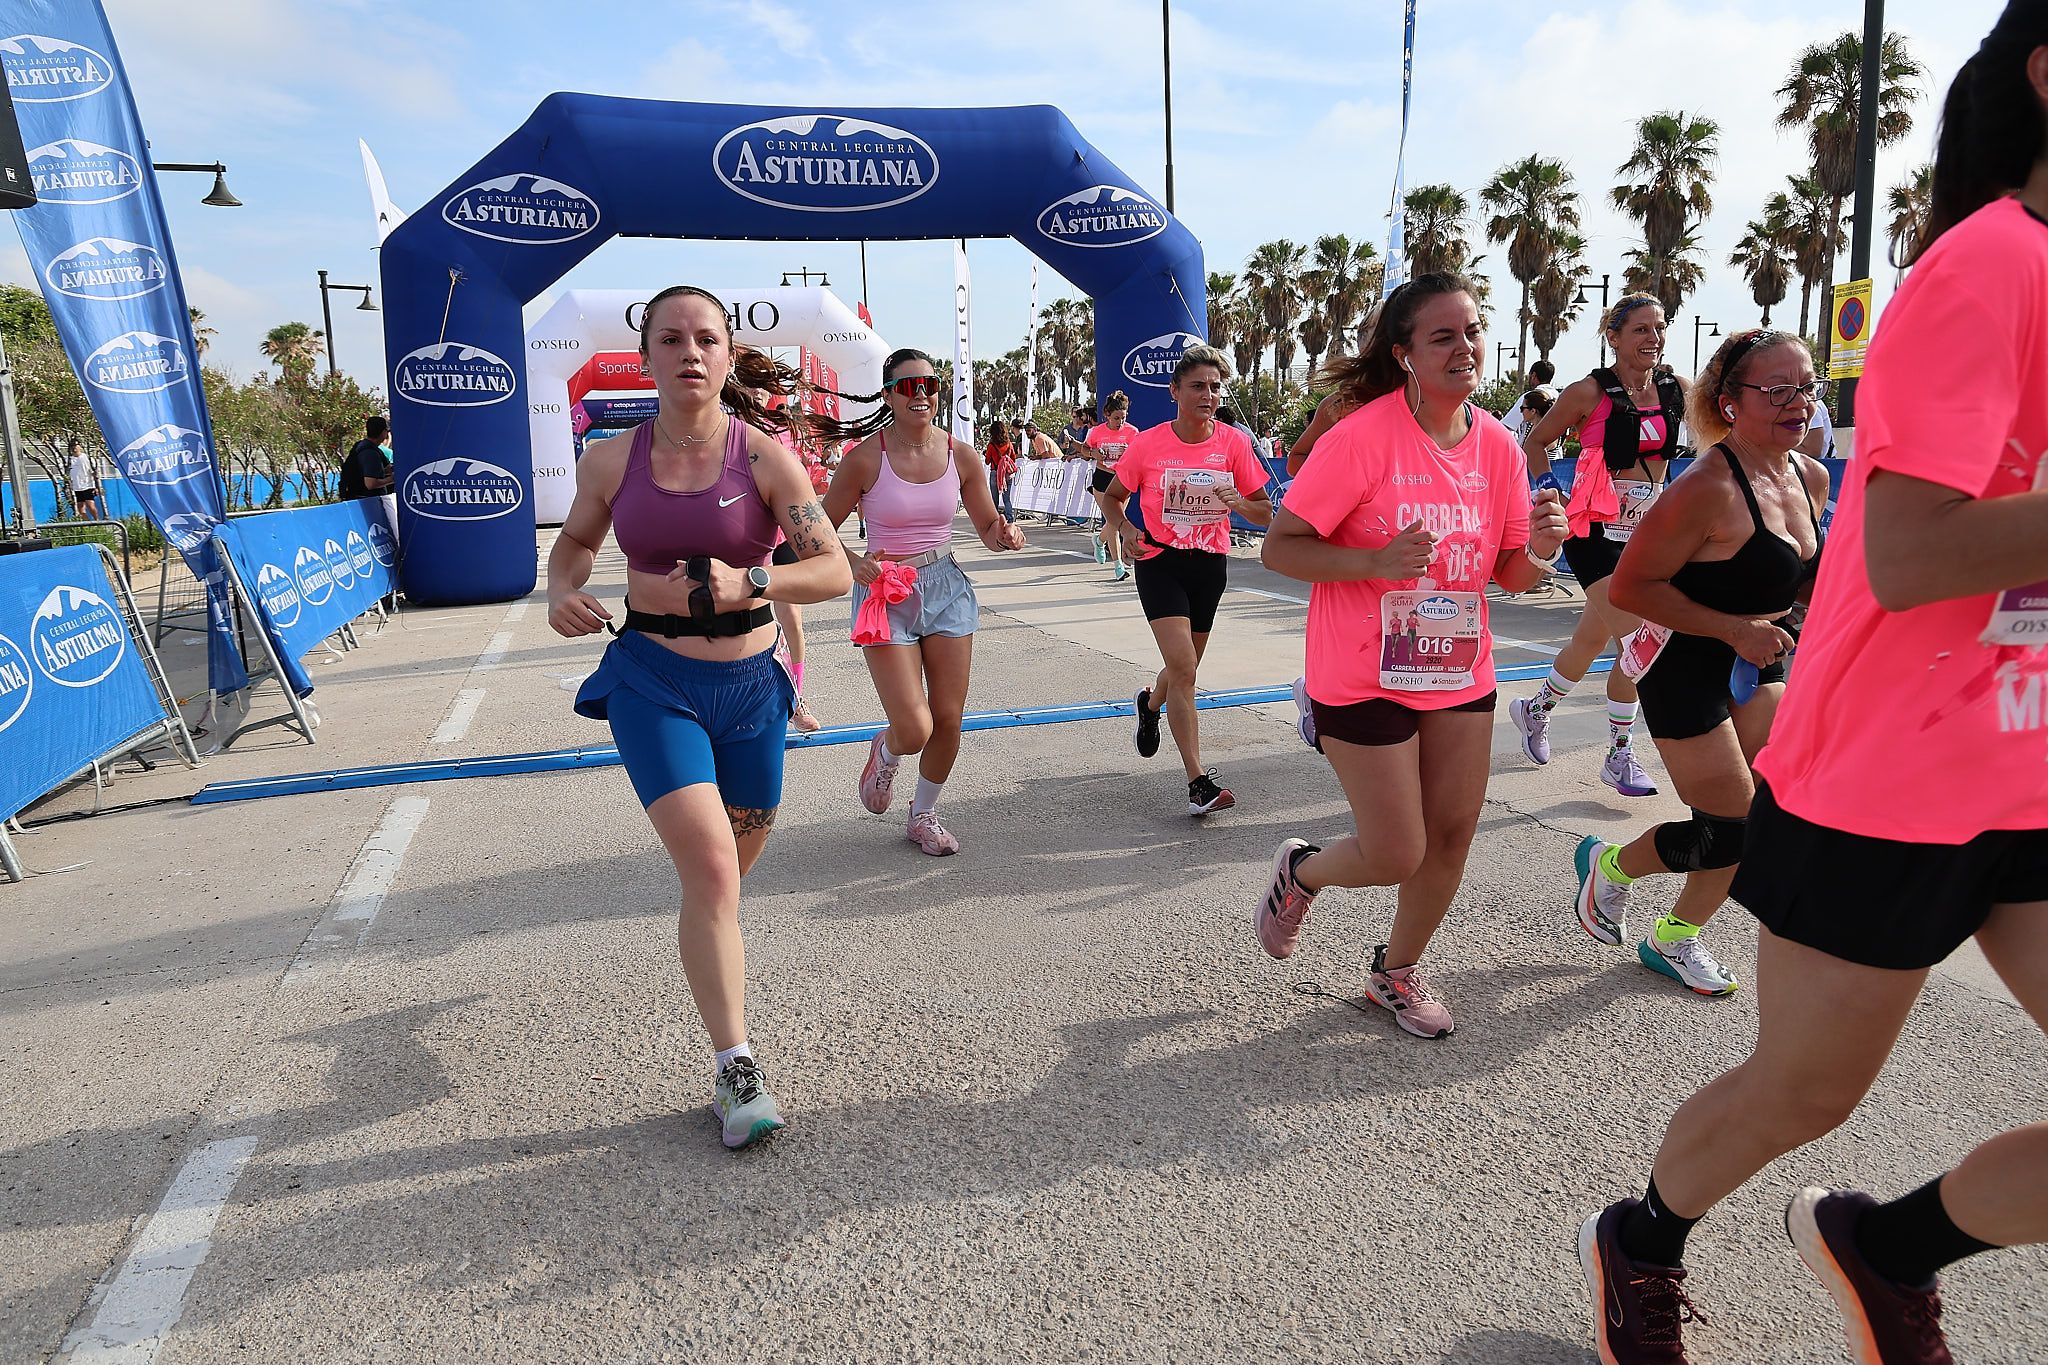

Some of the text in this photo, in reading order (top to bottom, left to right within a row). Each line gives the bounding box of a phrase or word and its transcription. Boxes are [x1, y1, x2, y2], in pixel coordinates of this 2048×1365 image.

[766, 140, 915, 154] CENTRAL LECHERA
[732, 140, 924, 186] ASTURIANA
[478, 195, 586, 210] CENTRAL LECHERA
[452, 198, 588, 230] ASTURIANA
[1068, 205, 1112, 216] CENTRAL
[1048, 212, 1162, 234] ASTURIANA
[625, 301, 780, 332] OHO
[824, 332, 867, 343] OYSHO
[530, 340, 580, 350] OYSHO
[464, 364, 506, 374] LECHERA
[400, 366, 510, 393] ASTURIANA
[529, 404, 560, 414] SHO
[1032, 467, 1065, 490] OYSHO
[1392, 474, 1432, 485] OYSHO
[409, 480, 517, 504] ASTURIANA
[1186, 496, 1210, 505] 016
[1420, 604, 1457, 614] ASTURIANA
[50, 618, 79, 638] CENTRAL
[2012, 619, 2048, 634] OYS
[1418, 637, 1453, 654] 016
[1391, 664, 1416, 672] CARRERA
[1391, 676, 1423, 685] OYSHO
